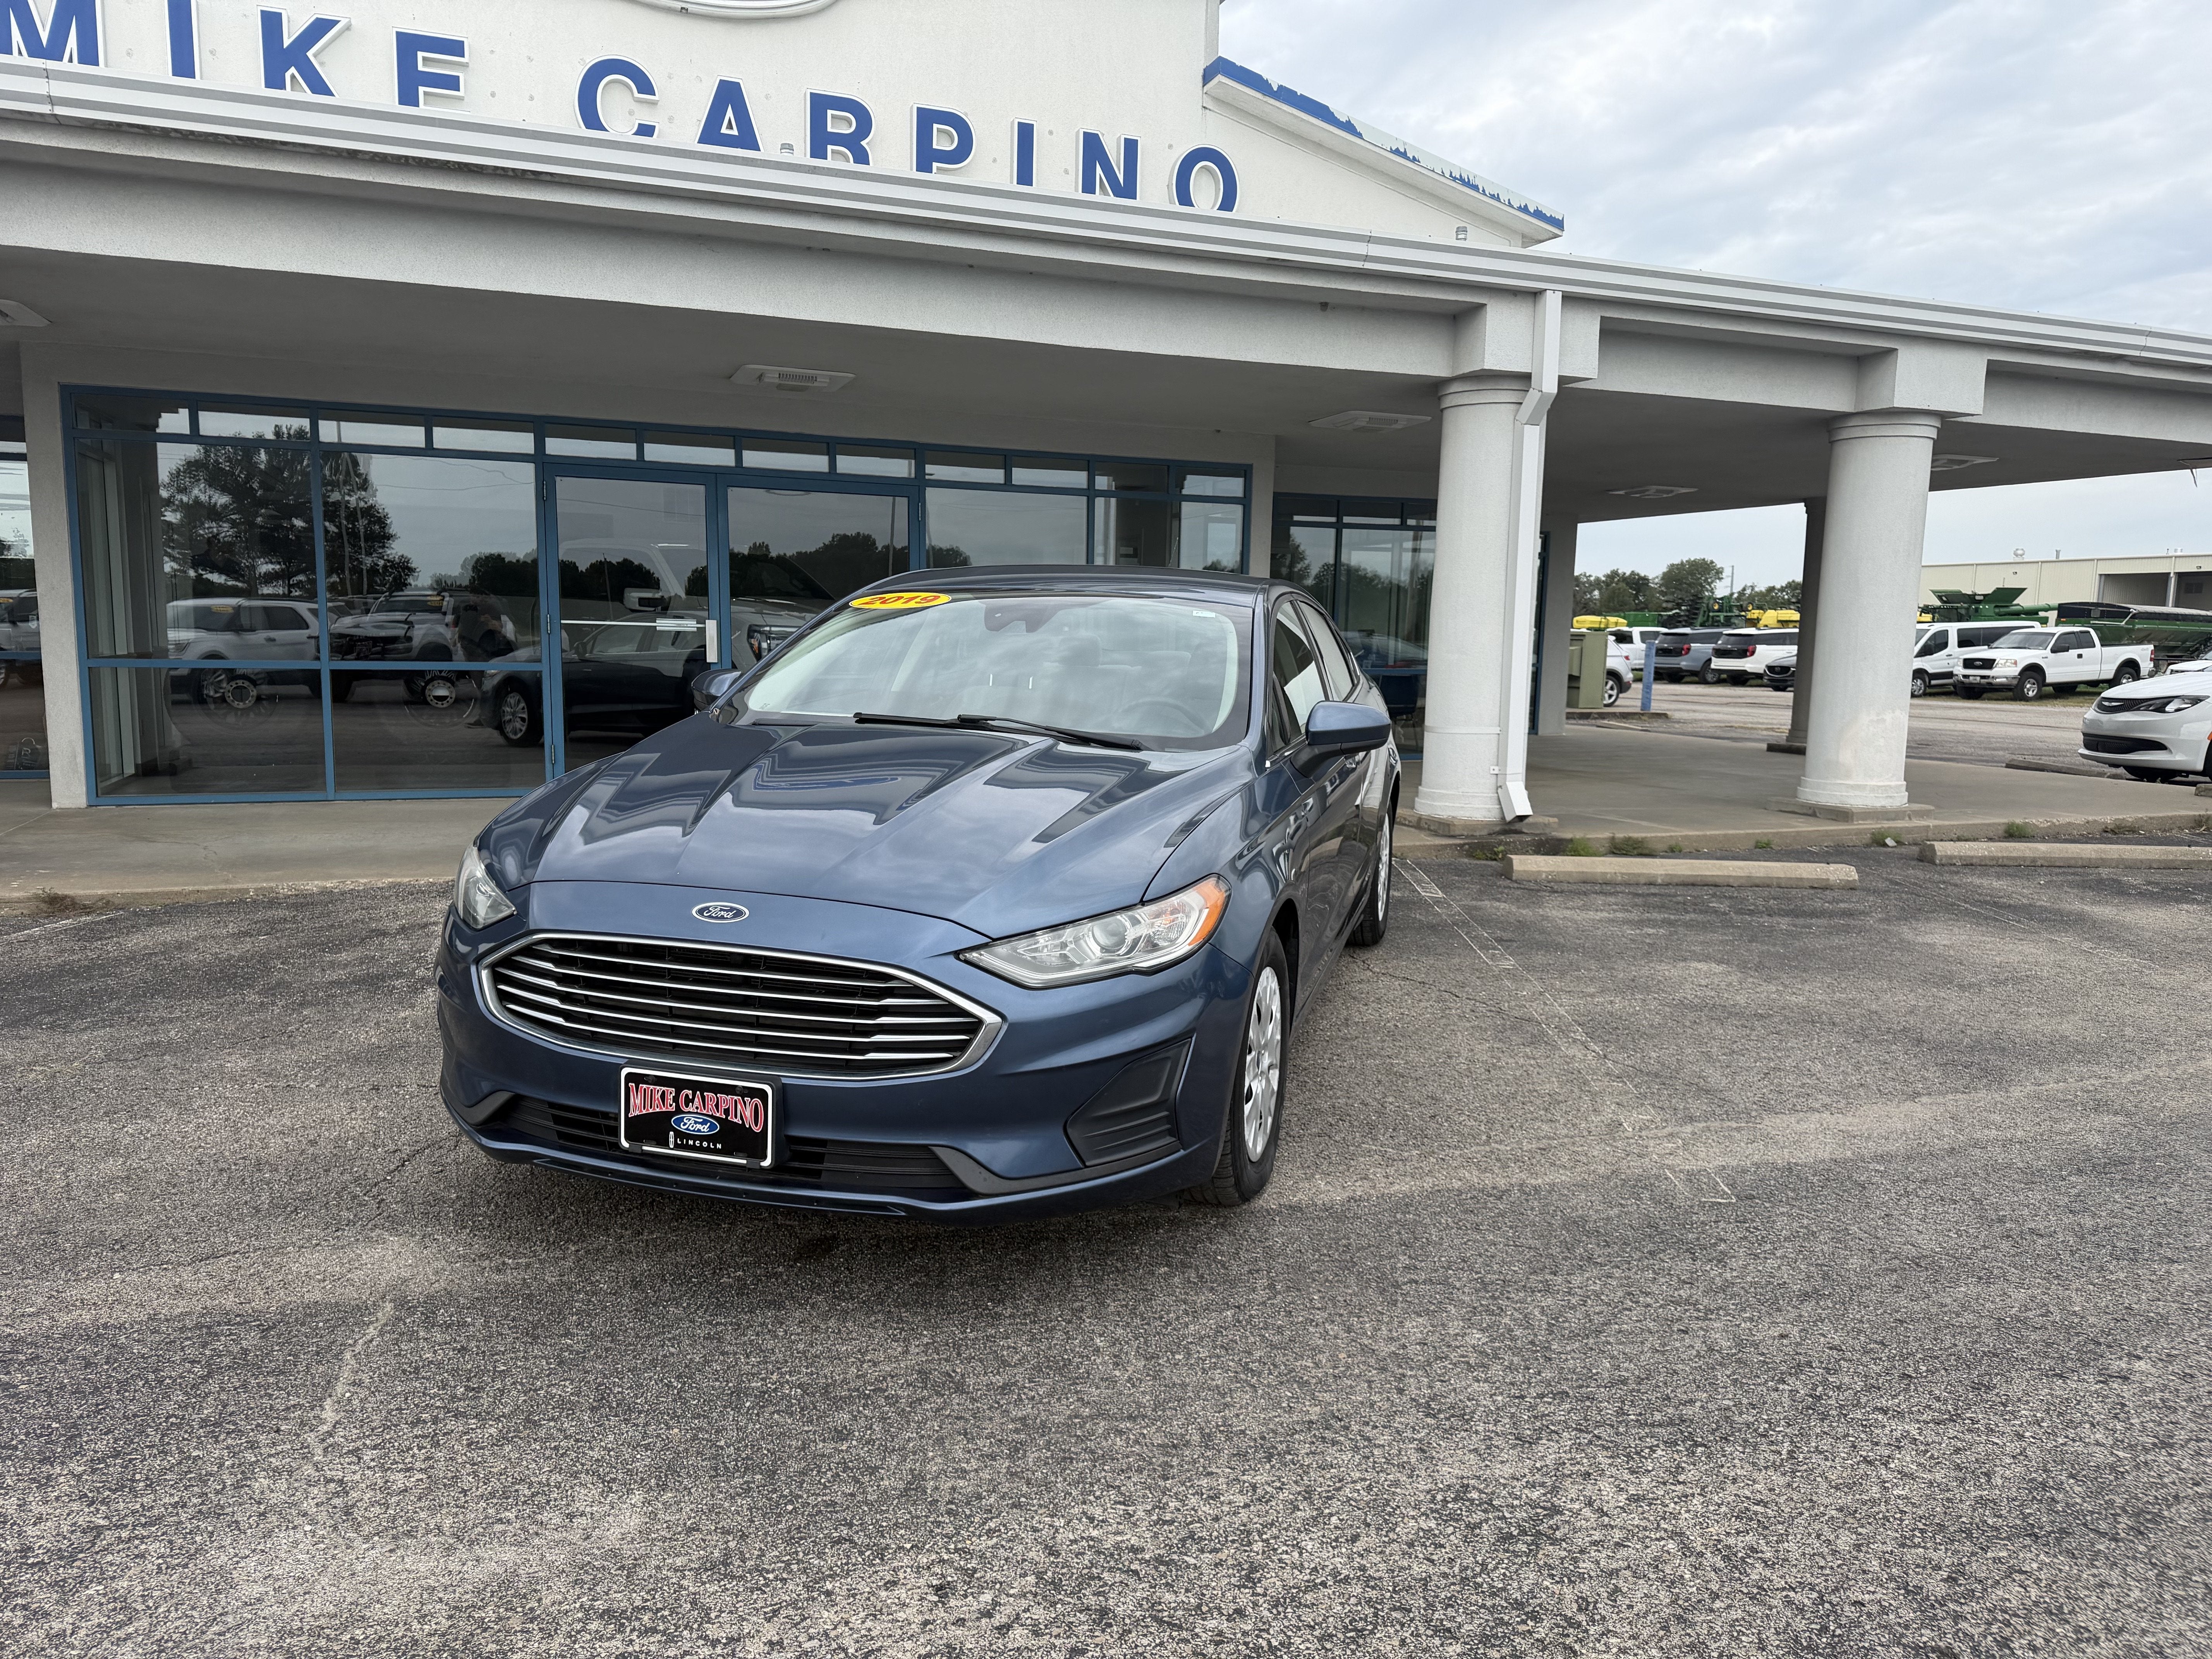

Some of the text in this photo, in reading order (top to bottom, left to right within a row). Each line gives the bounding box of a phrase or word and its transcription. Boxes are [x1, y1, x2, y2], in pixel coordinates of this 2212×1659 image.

[0, 0, 1240, 212] MIKE CARPINO
[858, 596, 941, 605] 2019
[703, 906, 737, 918] Ford
[629, 1083, 764, 1132] MIKE CARPINO
[680, 1116, 709, 1132] Ford
[677, 1138, 721, 1149] LINCOLN
